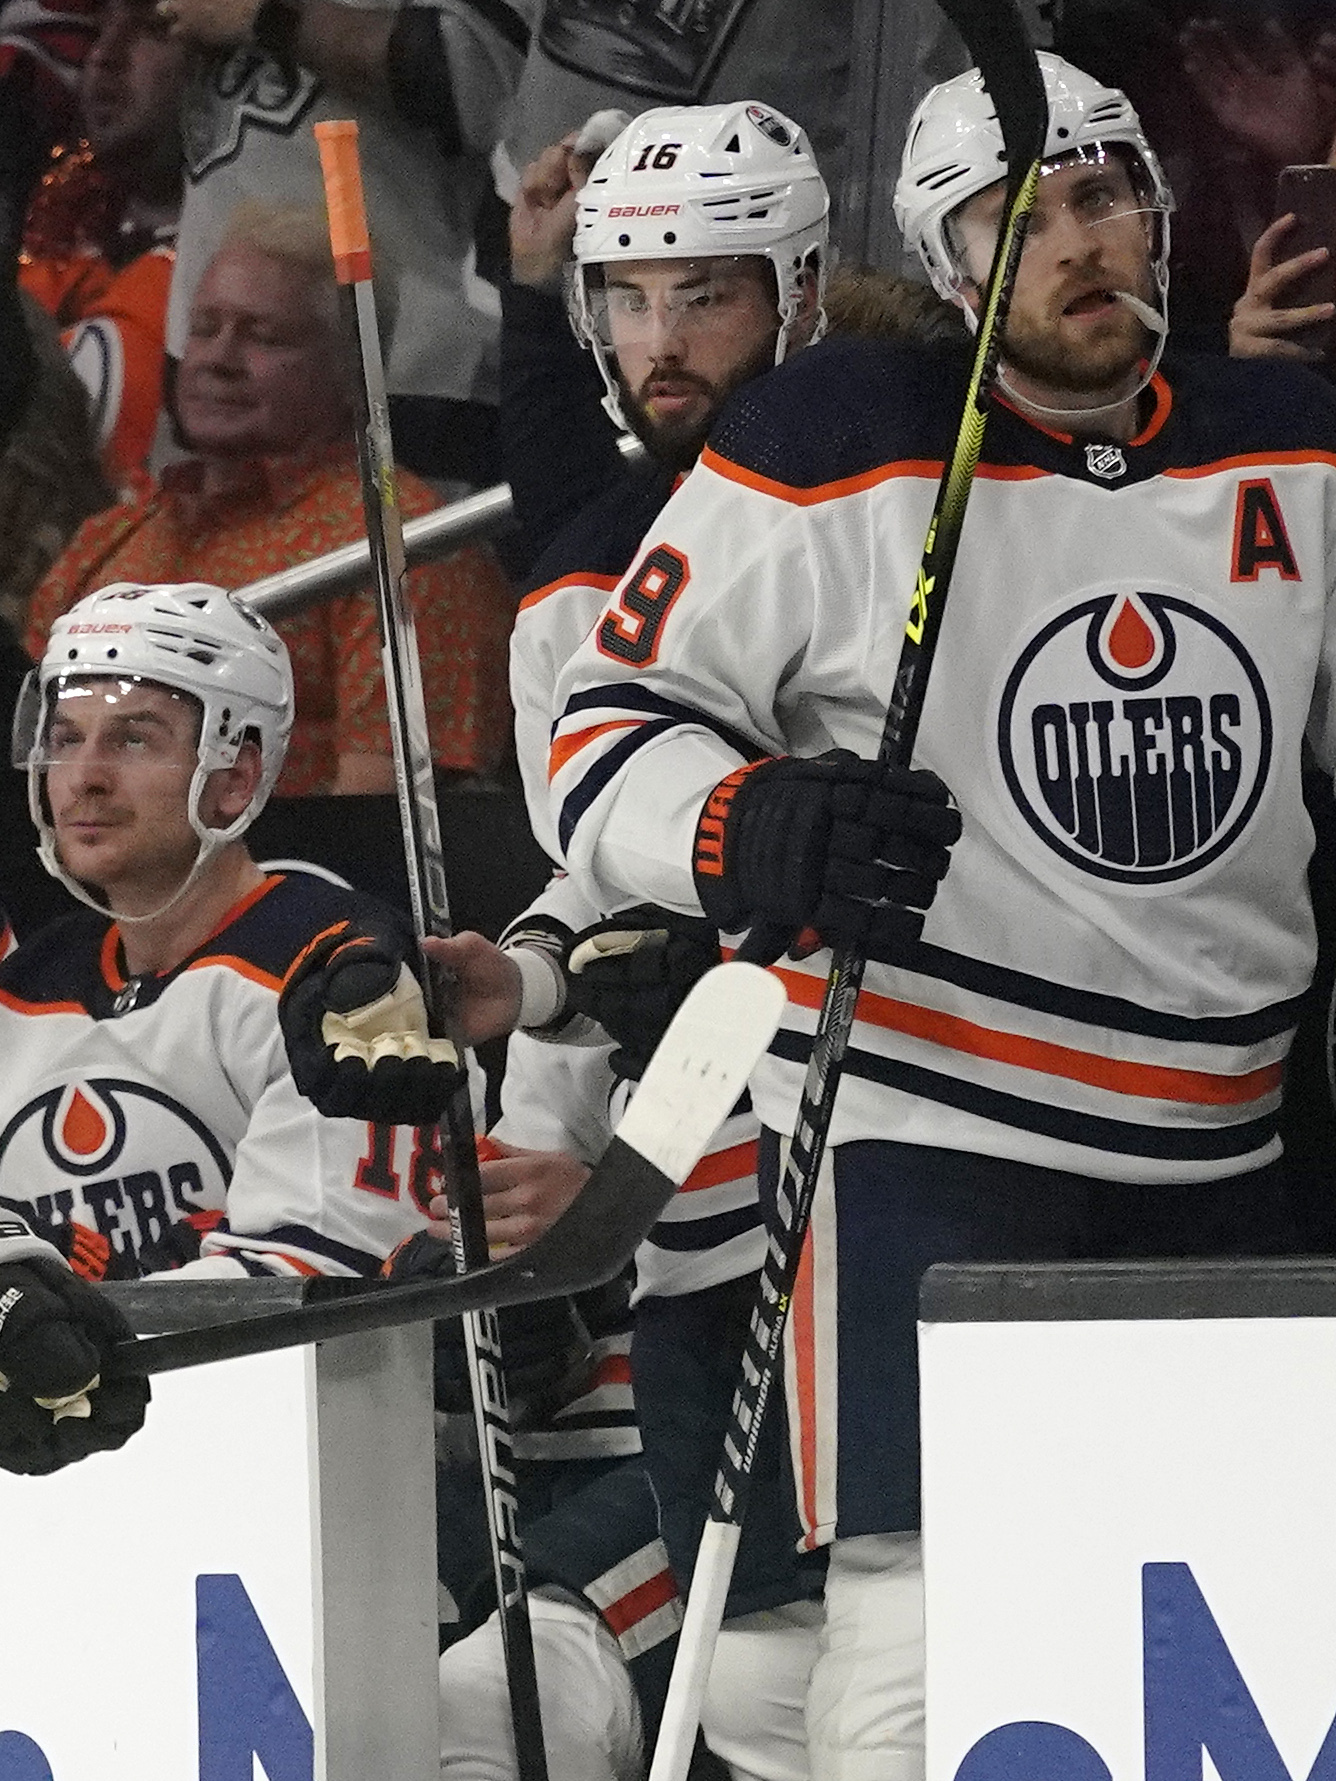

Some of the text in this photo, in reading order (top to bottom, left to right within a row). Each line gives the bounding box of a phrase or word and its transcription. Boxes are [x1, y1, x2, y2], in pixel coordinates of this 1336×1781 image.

[631, 143, 683, 172] 16
[1229, 477, 1302, 583] A
[1030, 692, 1242, 786] OILERS
[353, 1118, 447, 1222] 18
[743, 1367, 772, 1475] WARRIOR
[768, 1314, 784, 1361] ALPHA
